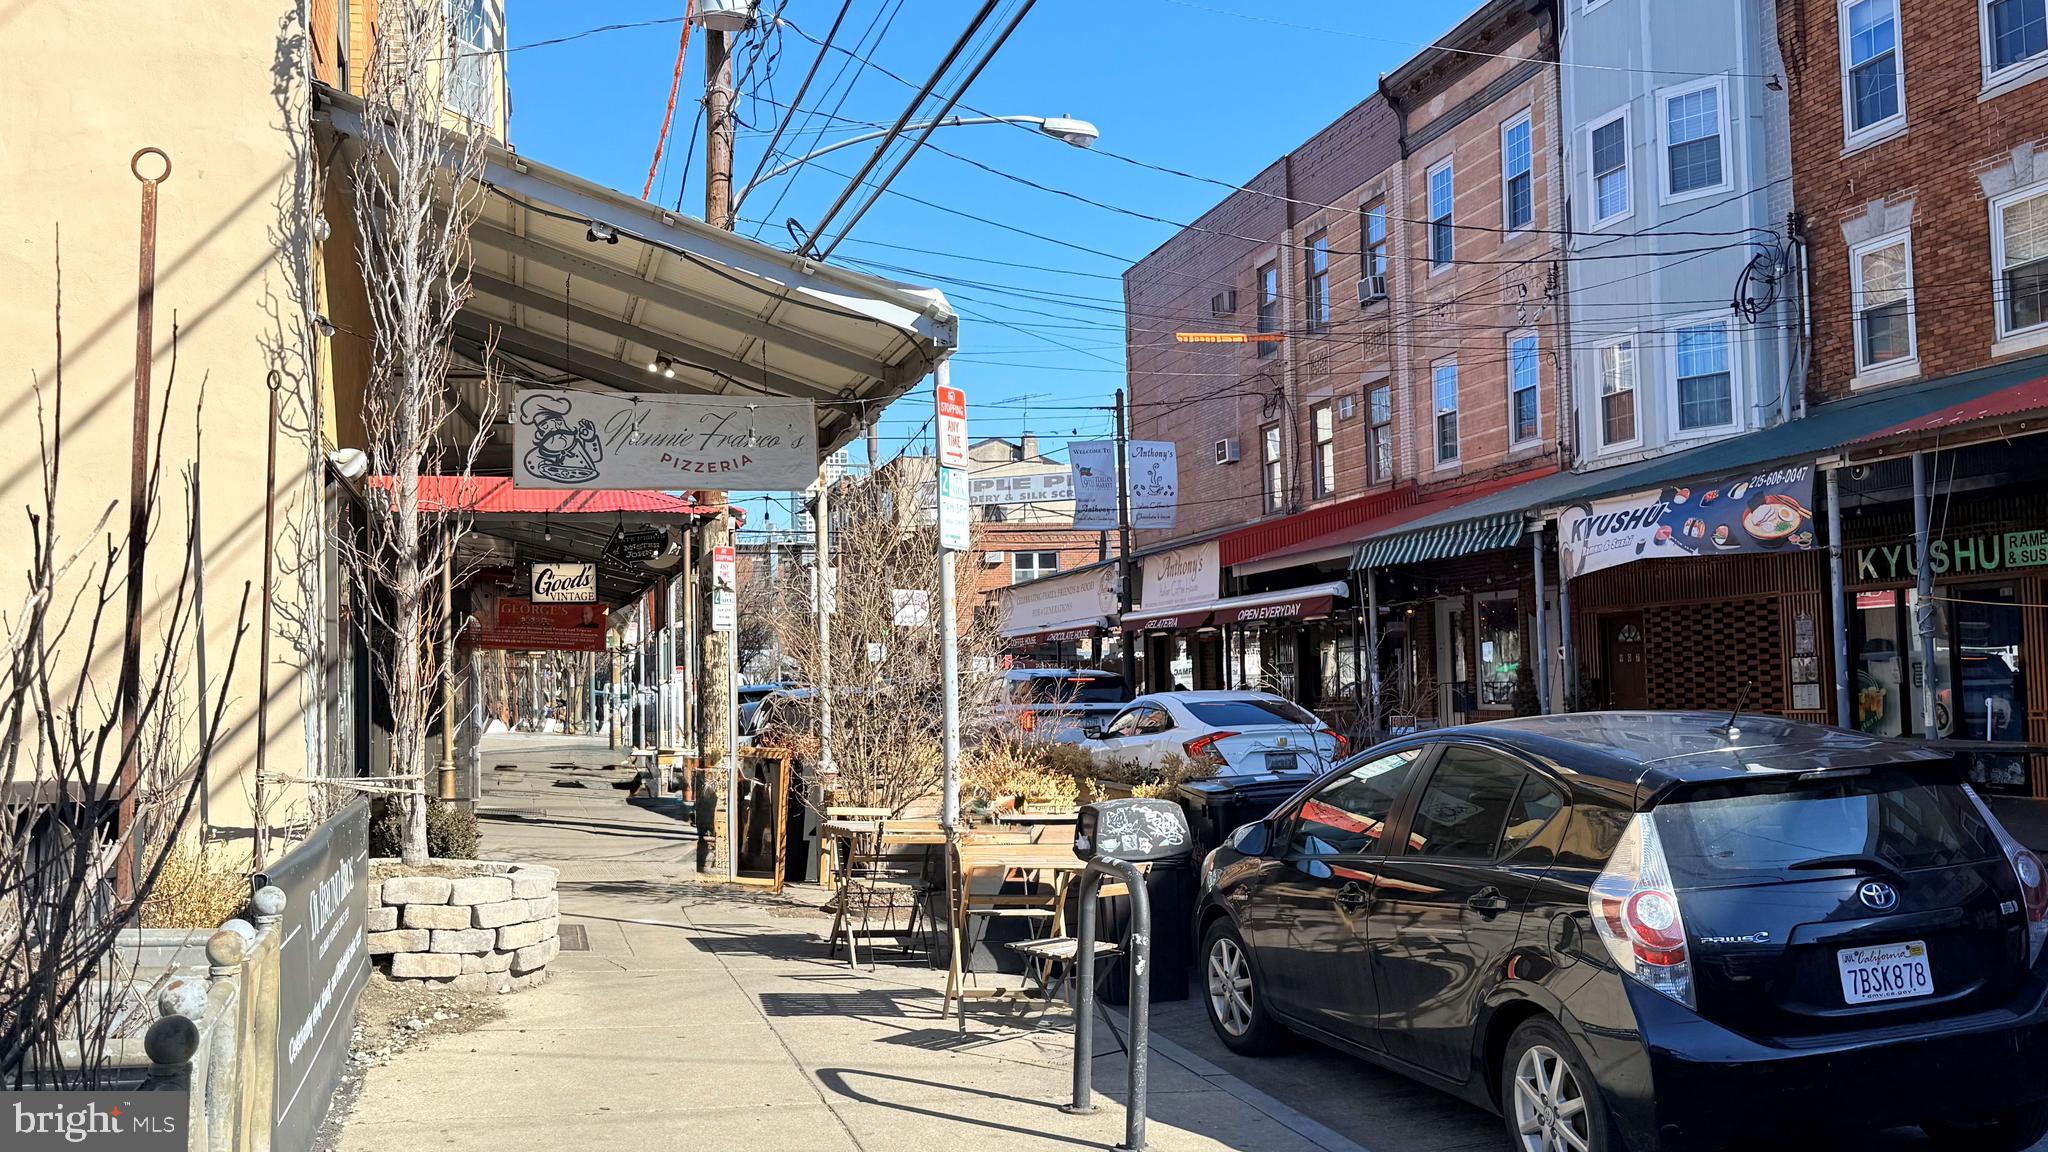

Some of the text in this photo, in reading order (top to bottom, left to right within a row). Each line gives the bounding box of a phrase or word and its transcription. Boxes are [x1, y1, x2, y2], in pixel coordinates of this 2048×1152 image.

[947, 391, 956, 401] NO
[940, 402, 964, 416] STOPPING
[603, 408, 695, 456] Nannie
[947, 420, 959, 433] ANY
[947, 434, 961, 449] TIME
[1131, 446, 1174, 461] Anthony's
[660, 452, 753, 473] PIZZERIA
[969, 477, 1032, 493] PLE
[1749, 466, 1809, 489] 215-606-0047
[1019, 491, 1047, 501] SILK
[1571, 503, 1666, 543] KYUSHU
[1610, 535, 1634, 549] Sushi
[1857, 534, 2000, 580] KYUSHU
[2008, 548, 2048, 564] & SUS
[1157, 555, 1203, 582] Anthony's
[550, 592, 595, 601] VINTAGE
[501, 603, 569, 616] GEORGE'S
[1237, 603, 1301, 621] OPEN EVERYDAY
[1144, 617, 1178, 629] GELATERIA
[1025, 635, 1037, 645] HOUSE
[1046, 629, 1090, 641] CHOCOLATE HOUSE
[1700, 935, 1753, 944] PRIUS
[1857, 949, 1911, 965] California
[1847, 962, 1926, 995] 7BSK878
[1867, 989, 1912, 999] dmv.ca.gov
